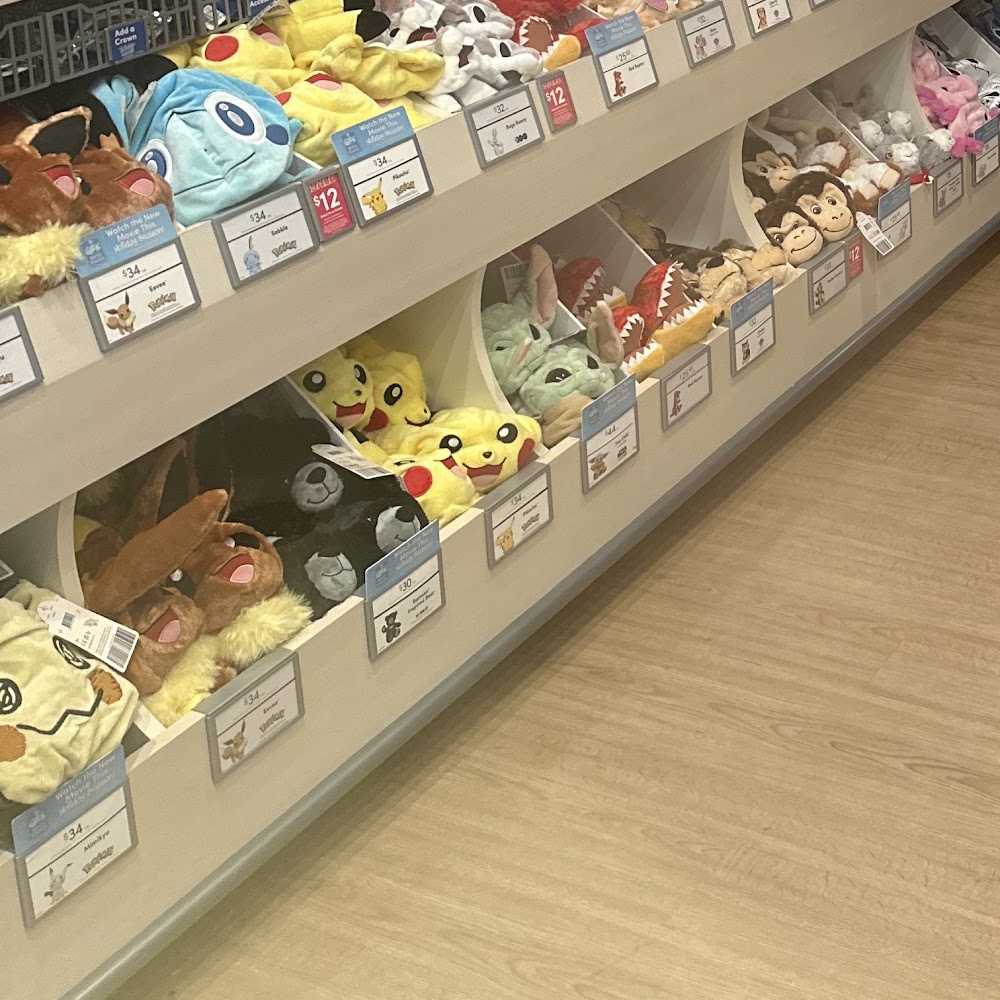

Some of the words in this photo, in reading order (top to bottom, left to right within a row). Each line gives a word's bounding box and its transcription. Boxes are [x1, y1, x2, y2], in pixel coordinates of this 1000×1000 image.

[114, 26, 129, 38] Add
[114, 34, 138, 46] Crown
[545, 86, 566, 106] $12
[373, 156, 388, 168] $34
[313, 187, 341, 211] $12
[104, 222, 129, 238] Watch
[129, 217, 143, 227] the
[143, 211, 160, 221] New
[249, 210, 267, 223] $34
[116, 228, 140, 243] Movie
[140, 221, 156, 232] This
[122, 264, 142, 279] $34
[398, 577, 412, 592] $30
[243, 689, 261, 706] $34
[54, 777, 82, 801] Watch
[83, 768, 97, 780] the
[98, 754, 116, 770] New
[65, 781, 91, 804] Movie
[62, 822, 84, 843] $34
[83, 829, 111, 853] Mimikyu
